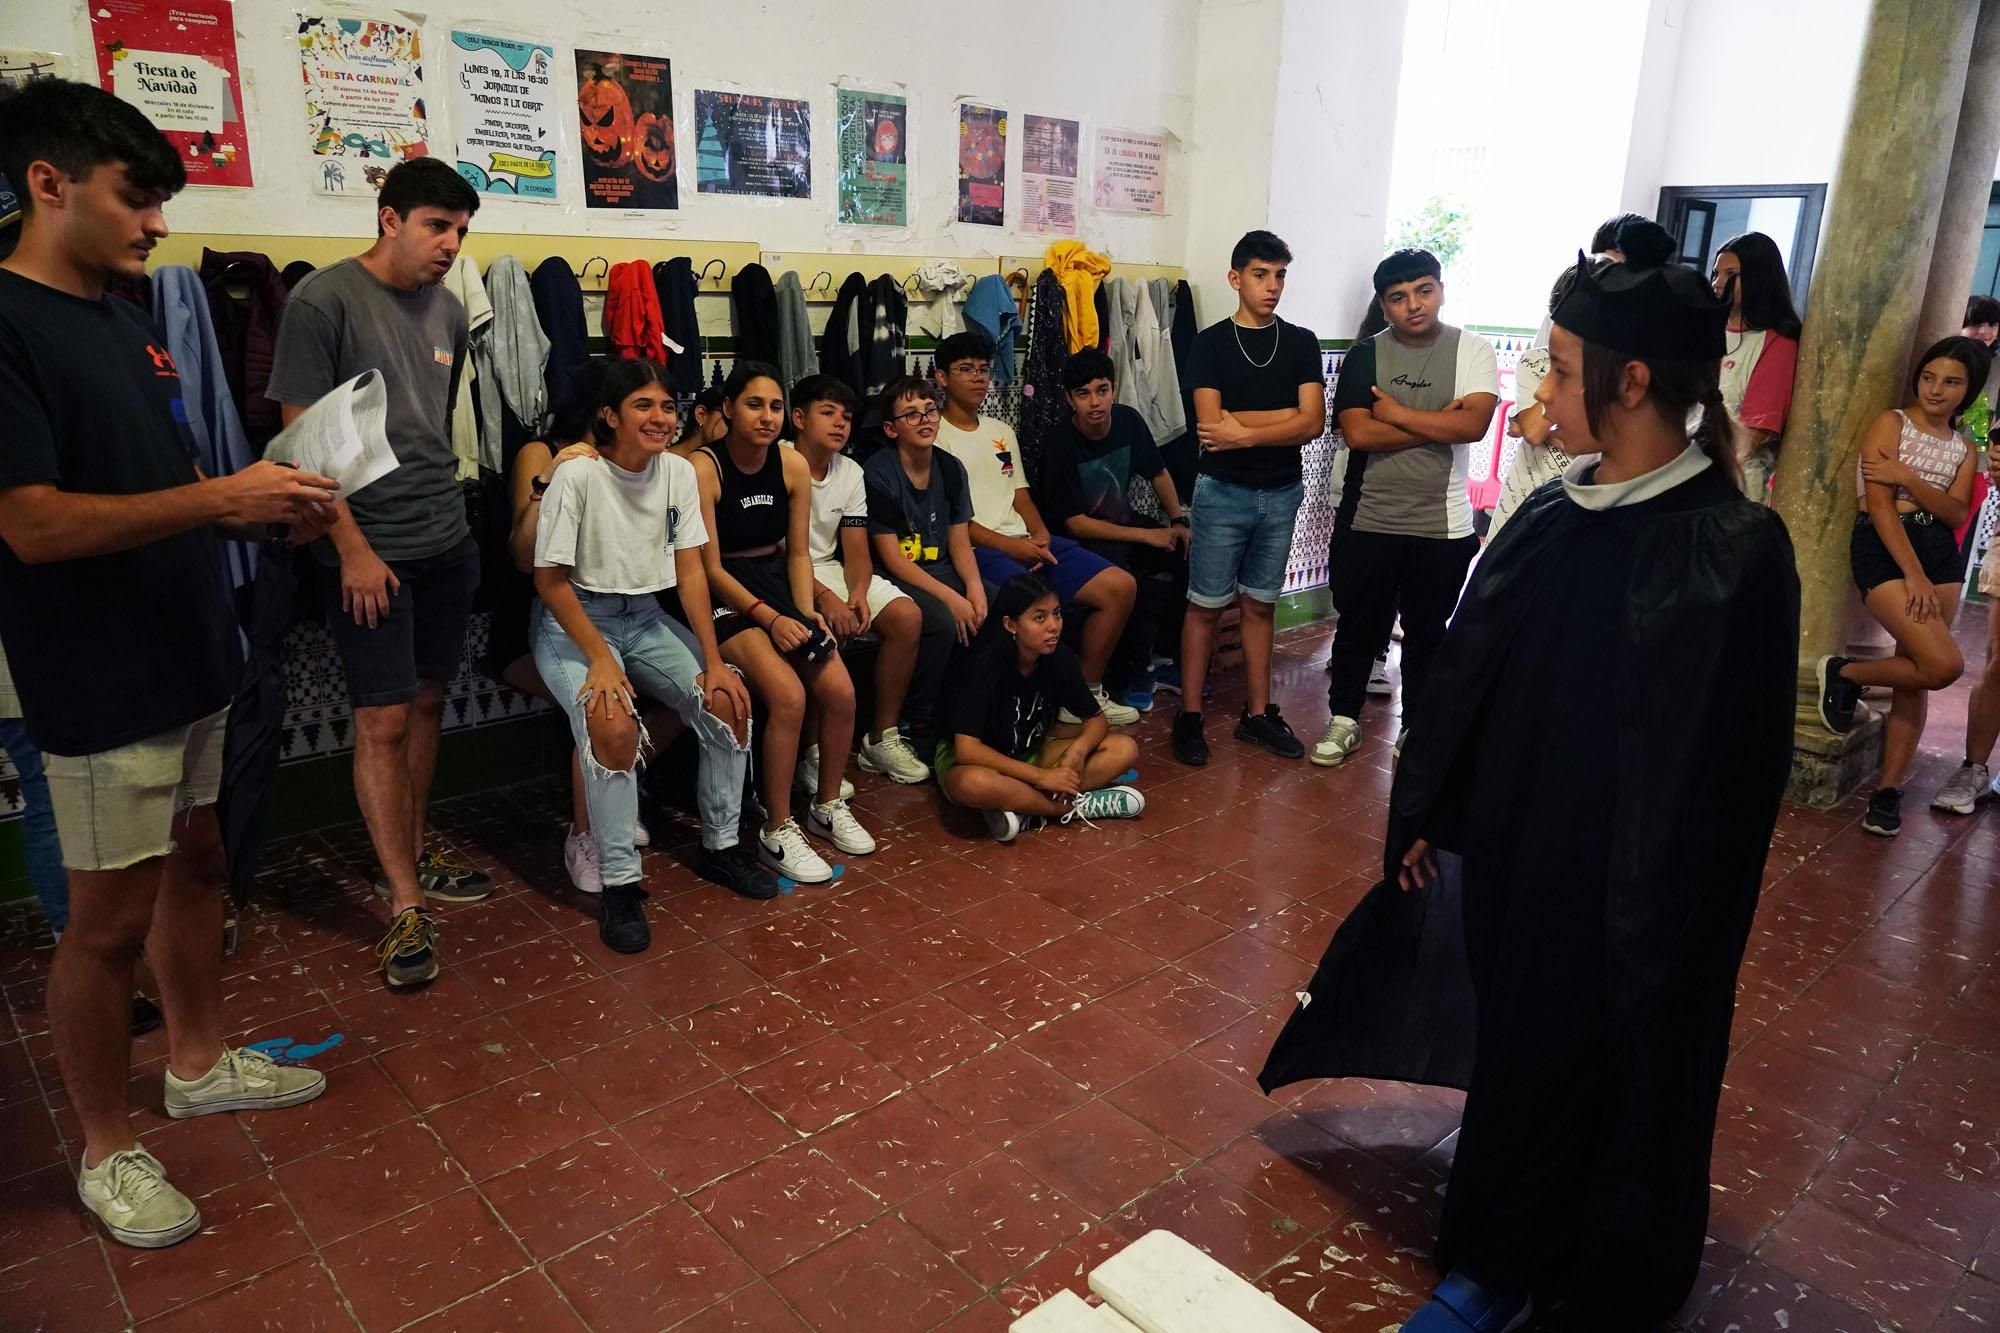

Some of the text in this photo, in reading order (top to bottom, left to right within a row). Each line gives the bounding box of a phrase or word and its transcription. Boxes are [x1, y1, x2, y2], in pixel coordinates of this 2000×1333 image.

[133, 62, 197, 79] Fiesta de
[320, 70, 412, 87] FIESTA CARNAVAL
[464, 62, 549, 85] LUNES 19, A LAS 16:30
[137, 78, 197, 95] Navidad
[483, 80, 530, 95] JORNADA DE
[502, 97, 509, 107] A
[511, 99, 521, 108] LA
[841, 95, 849, 114] CON
[849, 151, 857, 165] LA
[1915, 443, 1940, 458] THE
[740, 493, 774, 509] LOS ANGELES
